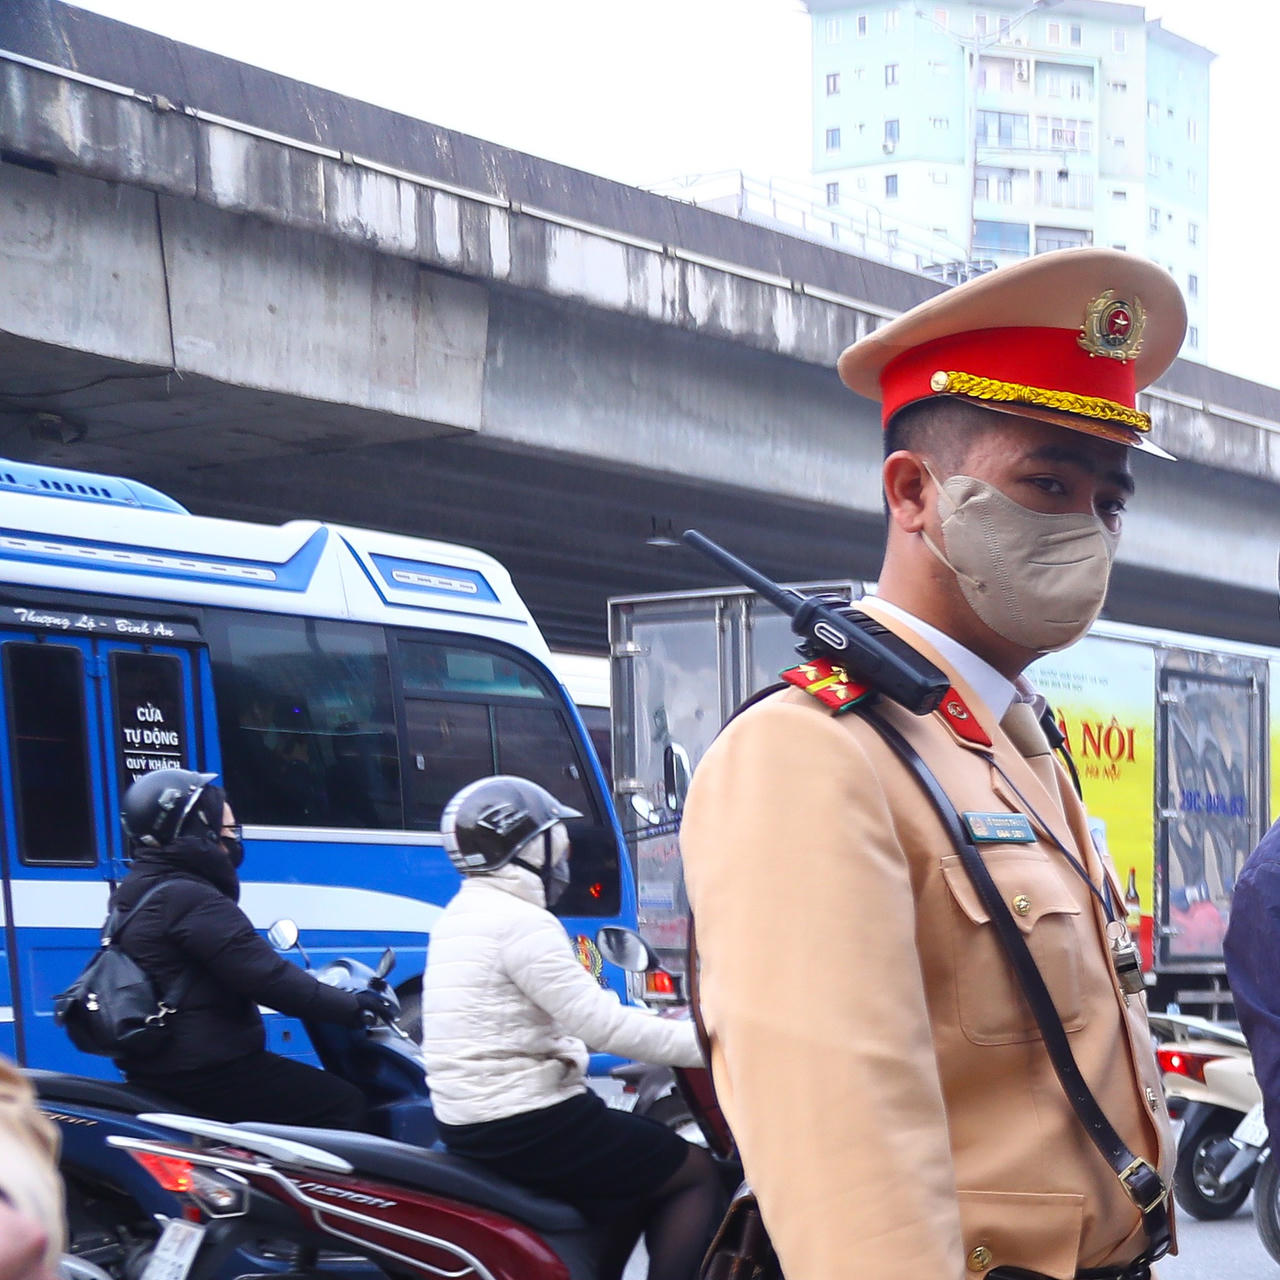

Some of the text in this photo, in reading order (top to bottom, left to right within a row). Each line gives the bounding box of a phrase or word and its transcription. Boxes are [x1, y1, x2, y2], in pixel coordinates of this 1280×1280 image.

[153, 622, 175, 637] An
[137, 703, 163, 723] CỬA
[124, 728, 179, 748] TỰ ĐỘNG
[1081, 715, 1136, 763] NỘI
